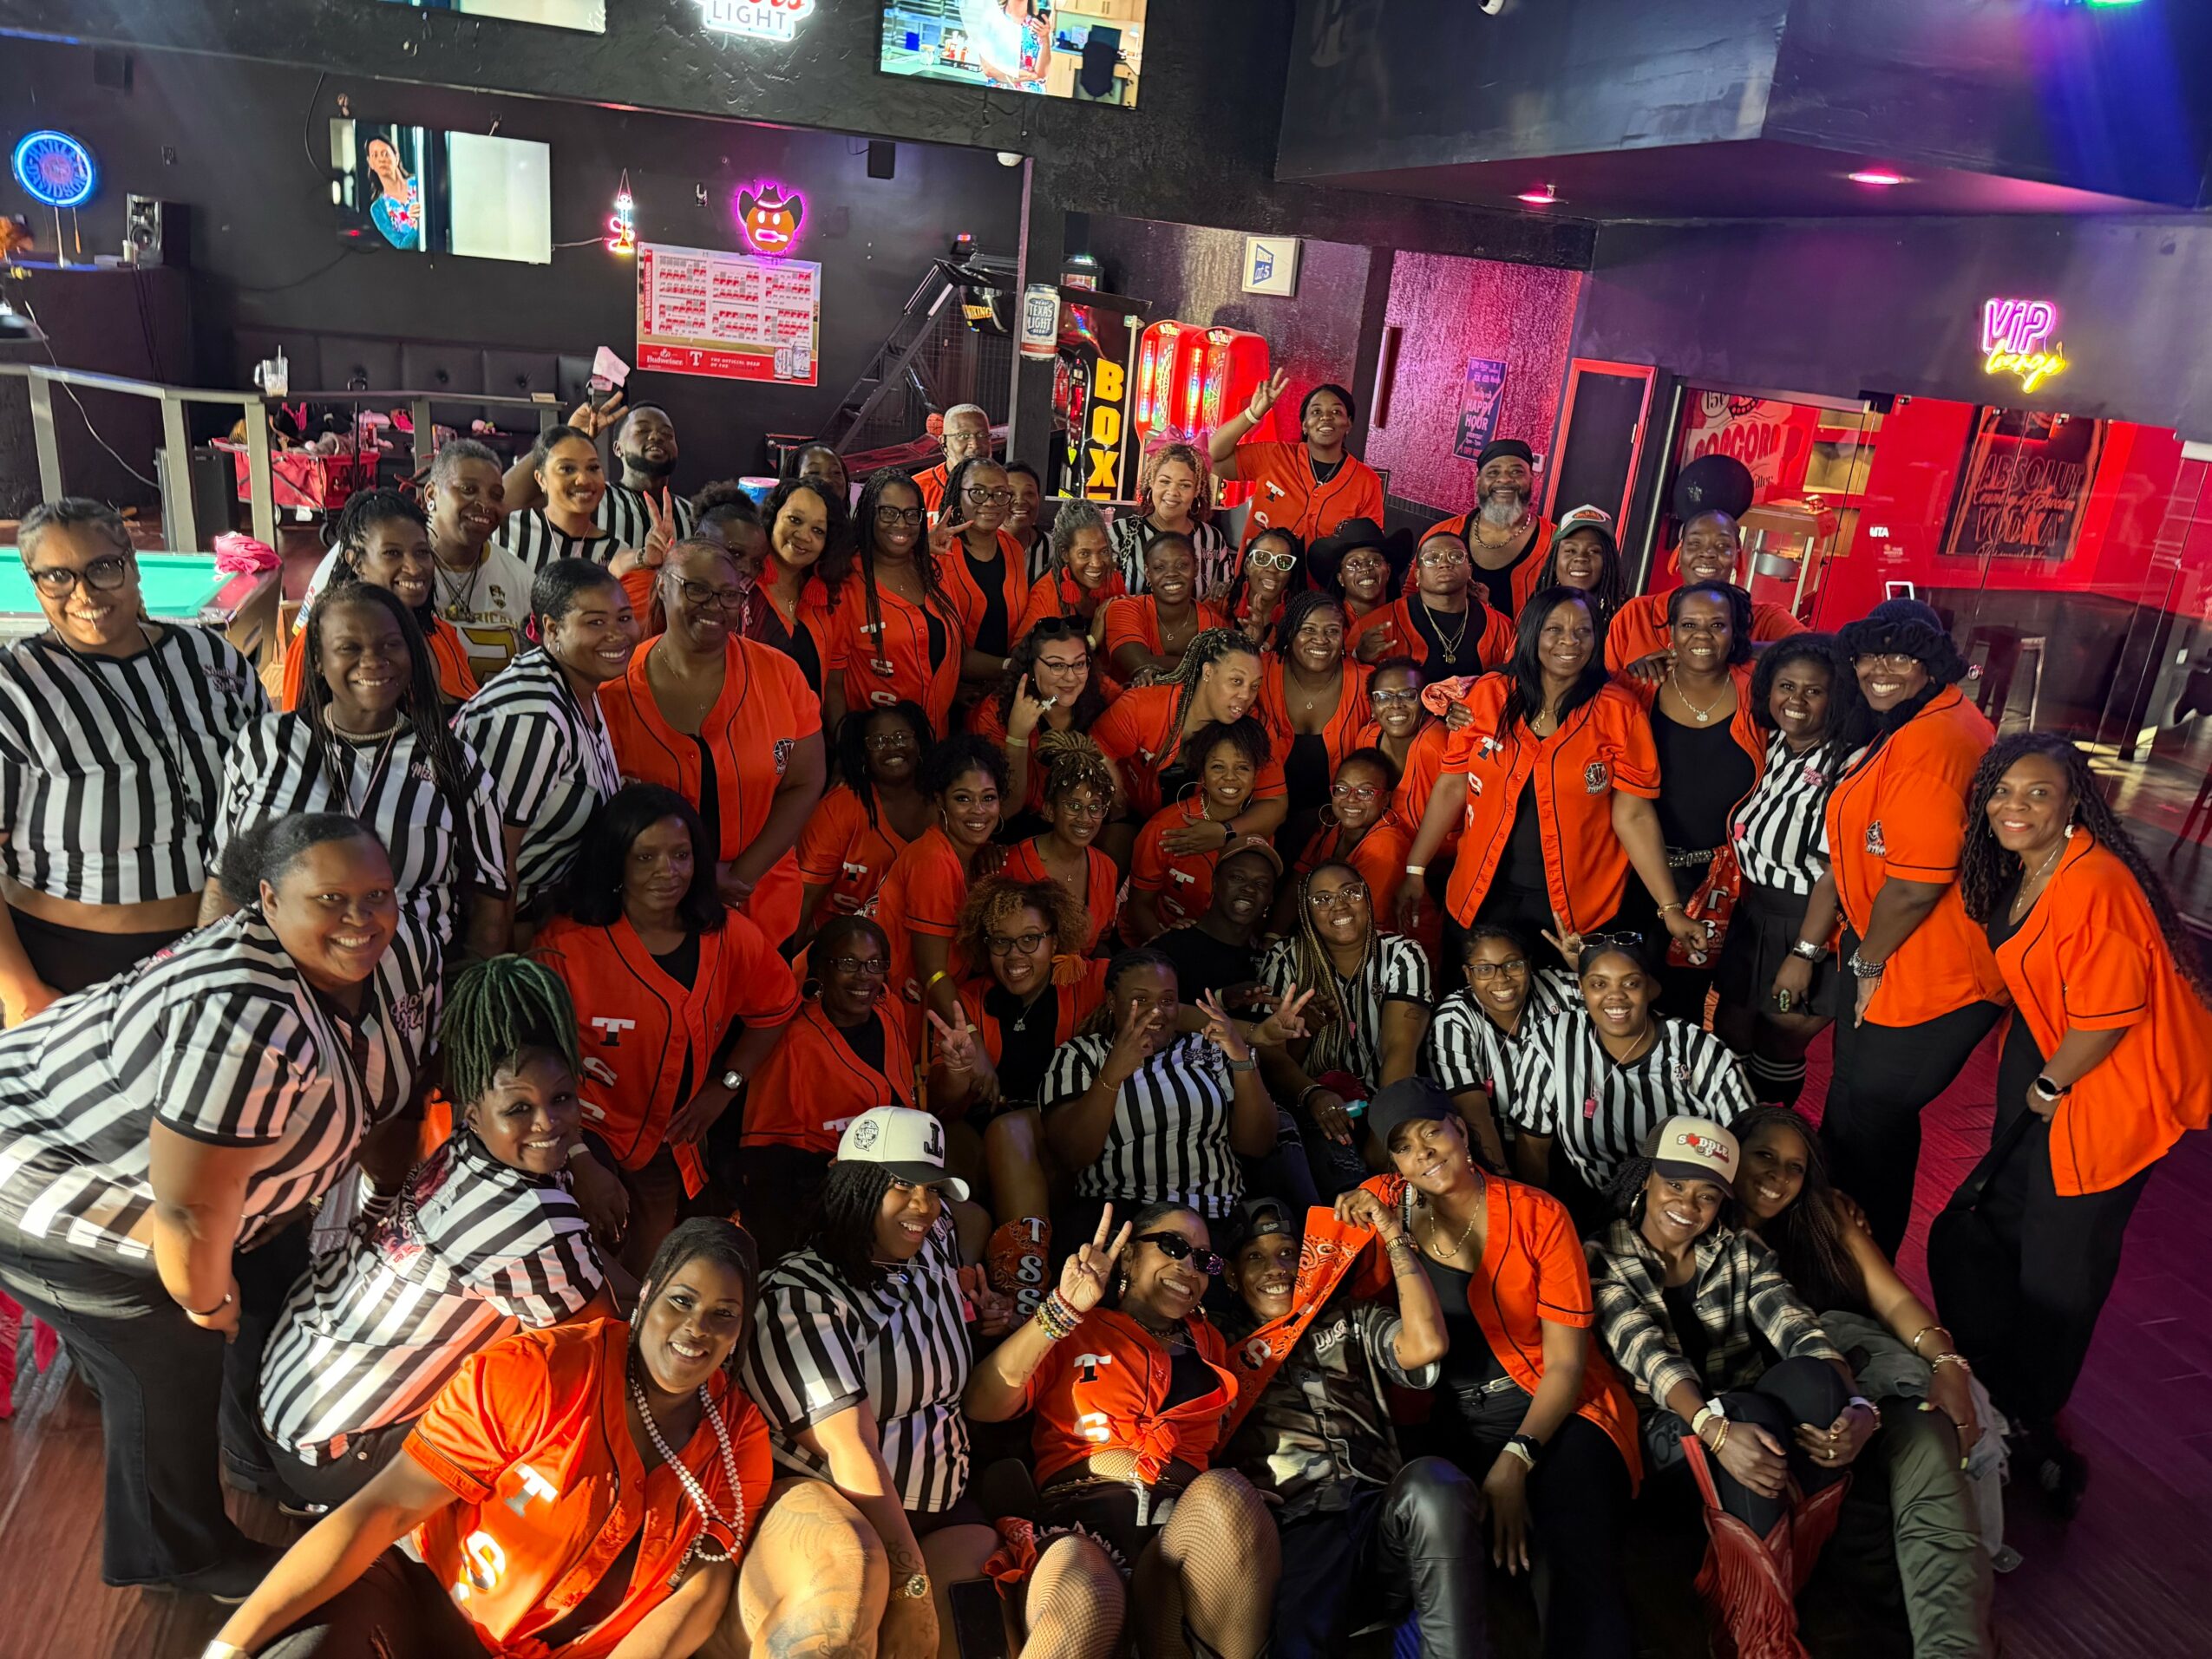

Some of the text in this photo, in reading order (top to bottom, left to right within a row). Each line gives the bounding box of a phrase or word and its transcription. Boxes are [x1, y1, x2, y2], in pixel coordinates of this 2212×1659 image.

[713, 1, 786, 29] LIGHT
[1029, 304, 1053, 317] TEXAS
[1027, 317, 1052, 330] LIGHT
[1983, 298, 2056, 354] VIP
[647, 355, 683, 365] Budweiser
[690, 351, 703, 366] T
[1466, 400, 1494, 415] HAPPY
[1087, 357, 1125, 500] BOX
[1464, 414, 1489, 431] HOUR
[1975, 454, 2084, 500] ABSOLUT
[1975, 507, 2060, 546] VODKA
[1678, 1133, 1730, 1158] SDDLE
[1312, 1329, 1334, 1352] DJ
